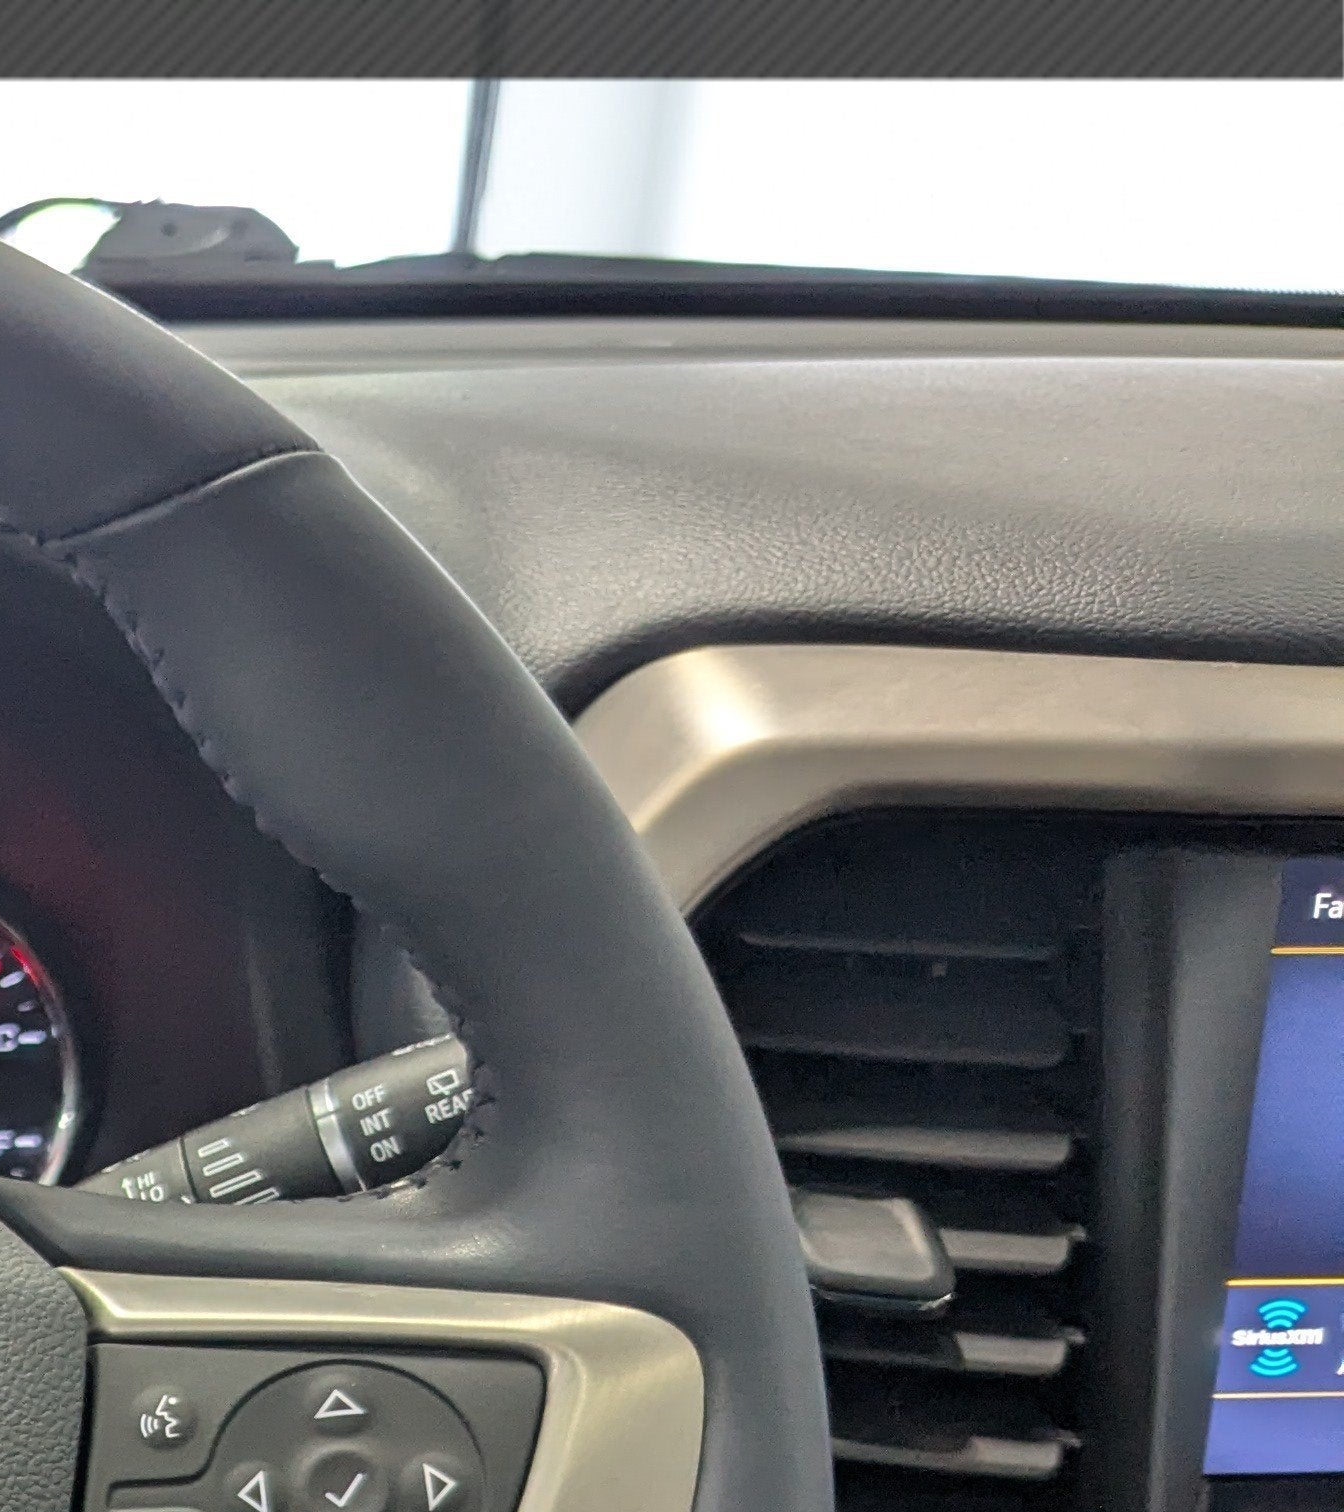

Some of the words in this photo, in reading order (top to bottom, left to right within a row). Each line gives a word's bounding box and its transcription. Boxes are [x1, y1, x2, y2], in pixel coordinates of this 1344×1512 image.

[352, 1084, 387, 1111] OFF
[360, 1107, 393, 1137] INT
[370, 1140, 402, 1163] ON
